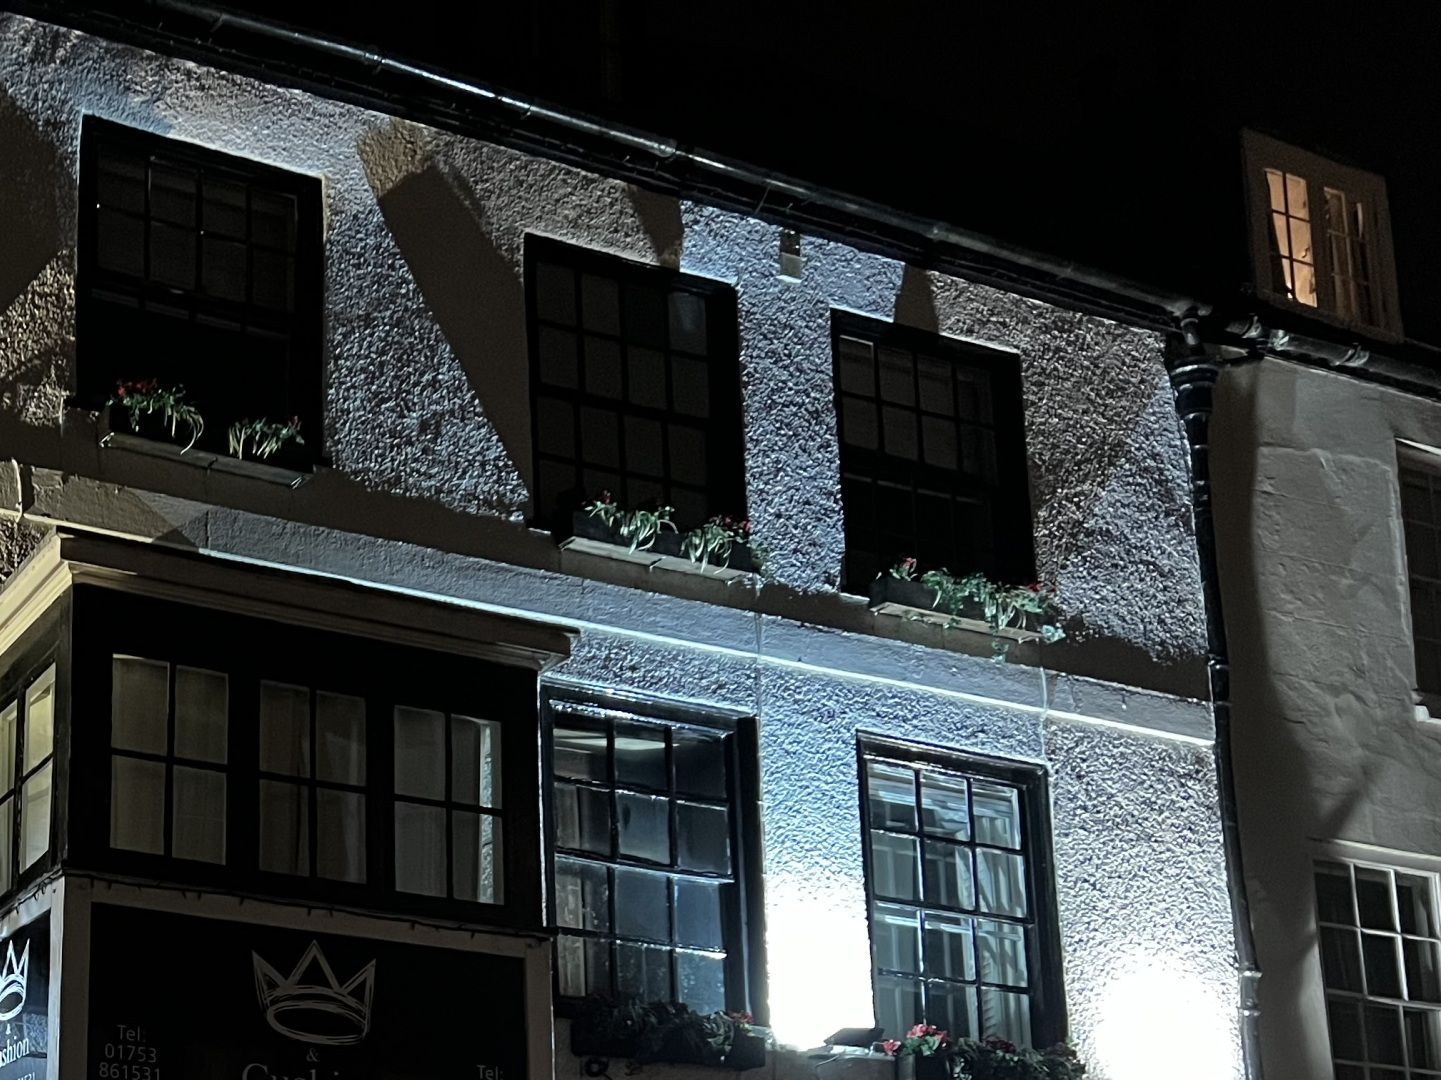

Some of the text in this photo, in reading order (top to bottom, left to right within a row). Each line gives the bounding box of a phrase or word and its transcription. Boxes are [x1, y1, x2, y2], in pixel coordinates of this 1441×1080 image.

[116, 1024, 146, 1042] Tel:
[103, 1043, 158, 1063] 01753
[305, 1048, 321, 1063] &
